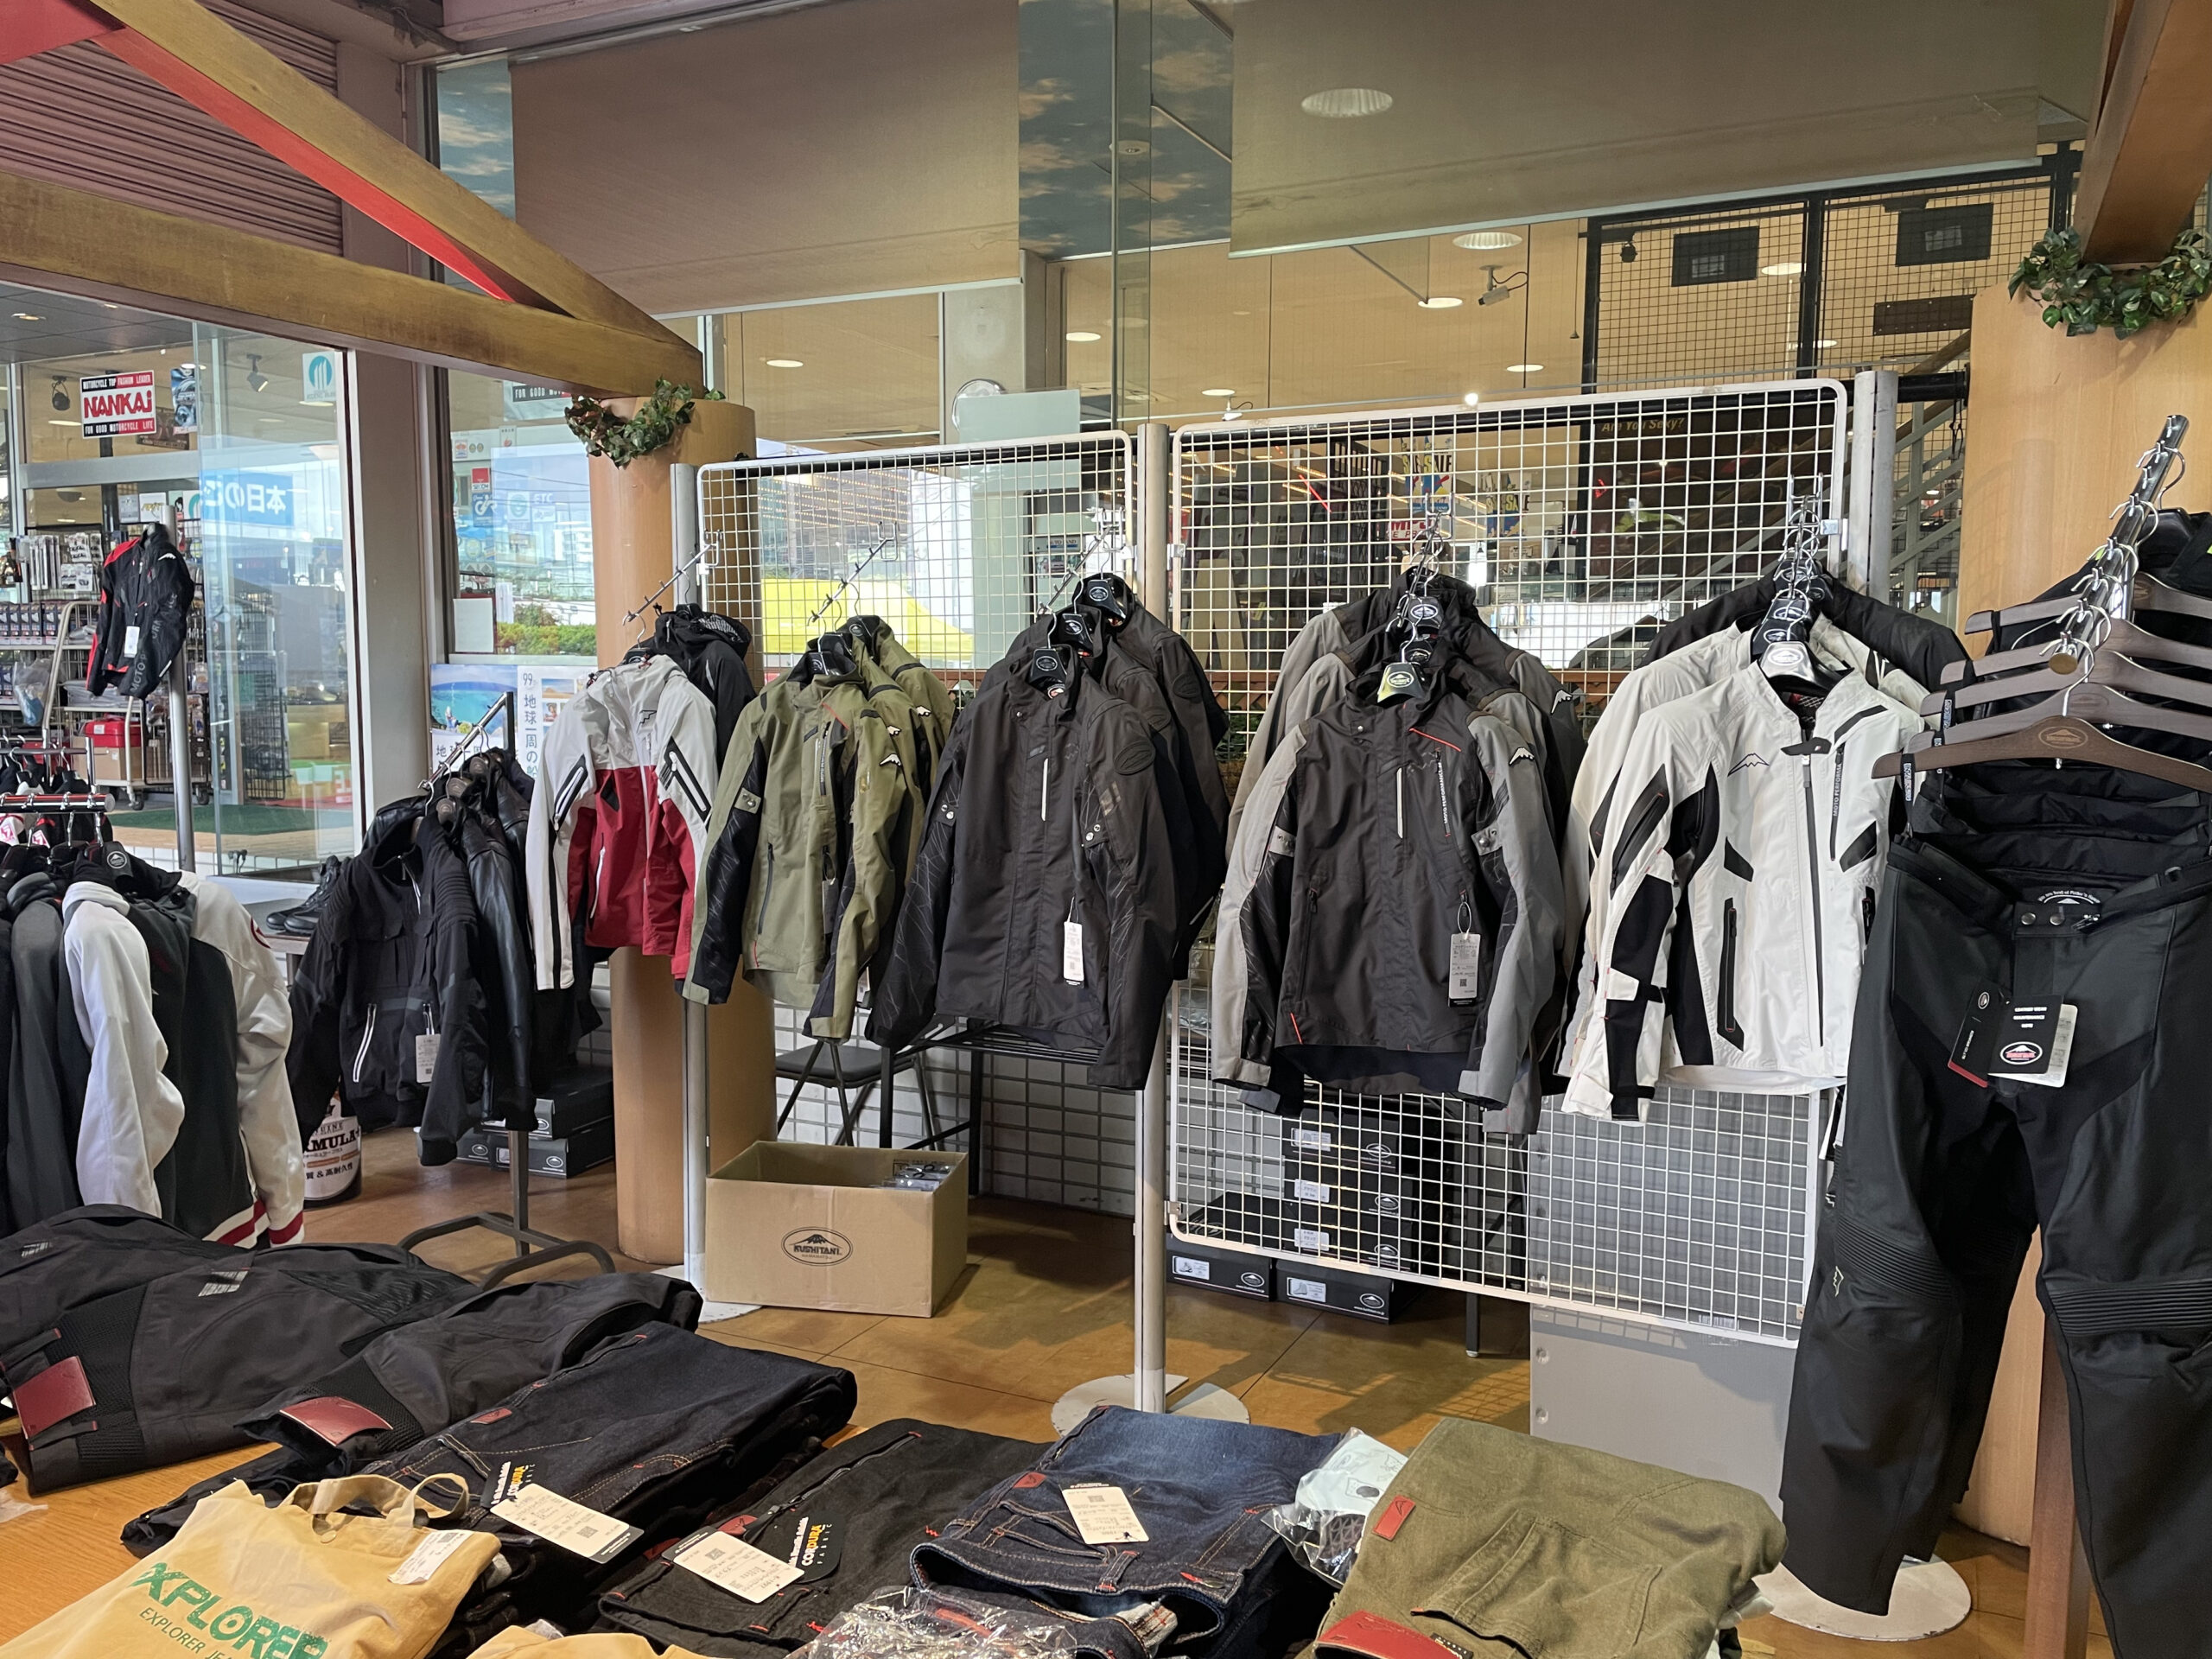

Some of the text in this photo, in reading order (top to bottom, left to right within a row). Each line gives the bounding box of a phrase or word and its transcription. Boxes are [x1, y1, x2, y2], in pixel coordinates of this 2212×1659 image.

[516, 388, 525, 397] FOR
[530, 387, 544, 397] GOOD
[96, 424, 107, 433] GOOD
[143, 420, 153, 429] LIFE
[533, 493, 554, 505] ETC
[793, 1245, 840, 1255] KUSHITANI
[801, 1523, 823, 1566] CORDURA
[139, 1607, 207, 1655] EXPLORER
